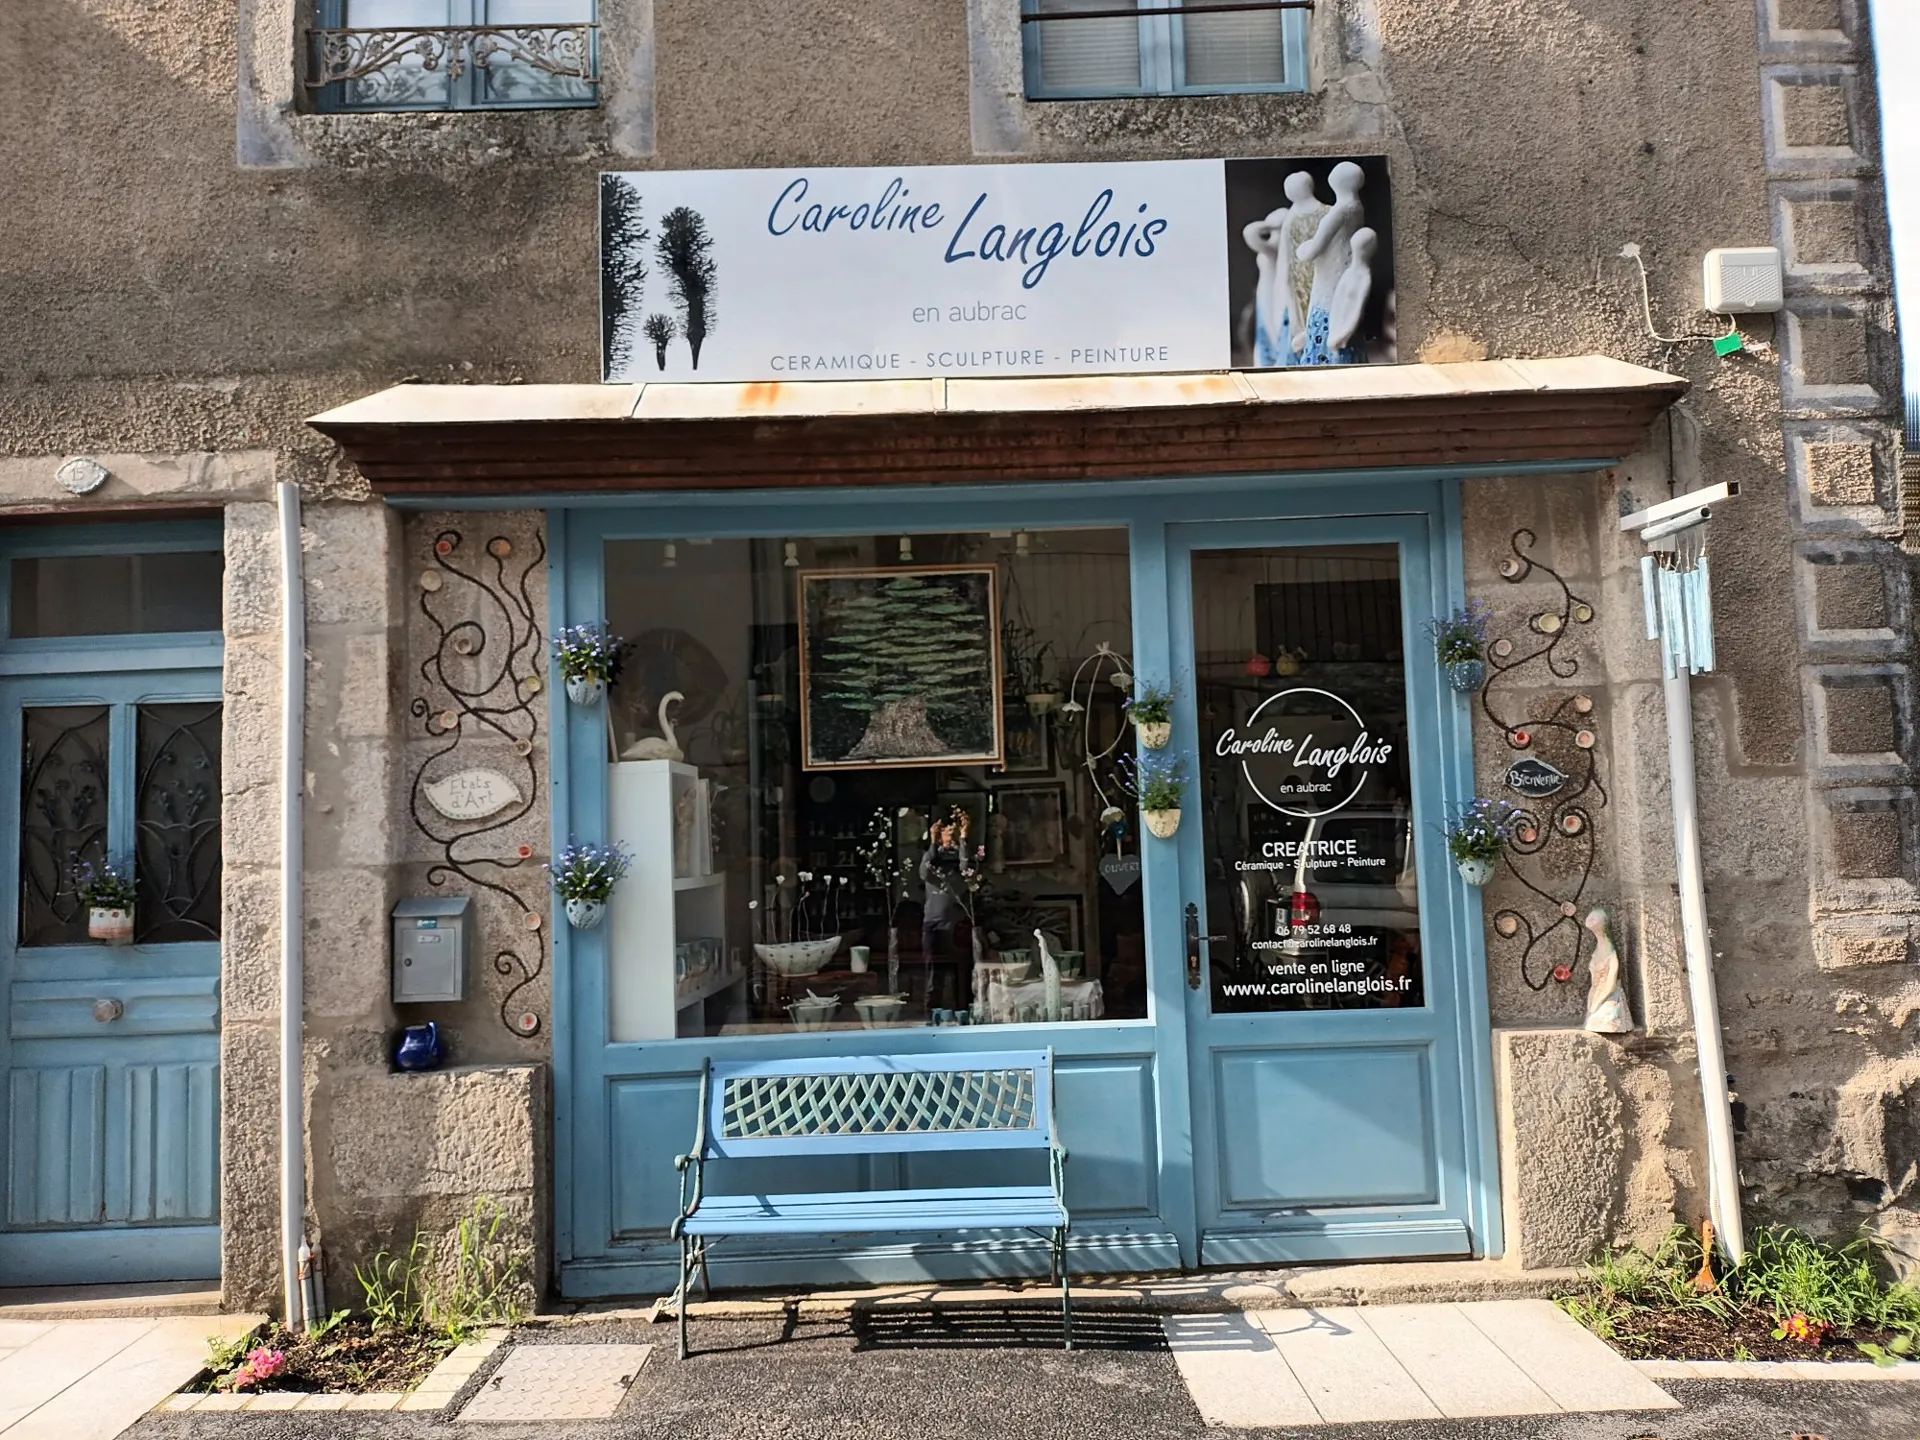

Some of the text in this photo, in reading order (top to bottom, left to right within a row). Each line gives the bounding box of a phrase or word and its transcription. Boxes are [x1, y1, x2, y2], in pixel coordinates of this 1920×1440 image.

[768, 177, 1168, 289] Caroline Langlois
[912, 302, 1028, 324] en aubrac
[770, 353, 901, 372] CERAMIQUE
[926, 349, 1045, 368] SCULPTURE
[1070, 346, 1169, 364] PEINTURE
[71, 467, 84, 482] 15
[1216, 727, 1393, 778] Caroline Langlois
[450, 776, 491, 795] Etats
[1280, 782, 1332, 794] en aubrac
[1509, 770, 1562, 787] Bienvenue
[451, 790, 496, 809] d'Art
[1262, 839, 1357, 858] CREATRICE
[1234, 860, 1284, 872] Céramique
[1293, 859, 1338, 871] Sulpture
[1347, 857, 1386, 868] Peinture
[1277, 923, 1352, 936] 06 79 52 68 48
[1268, 959, 1365, 976] vente en ligne
[1222, 975, 1413, 997] www.carolinelanglois.fr
